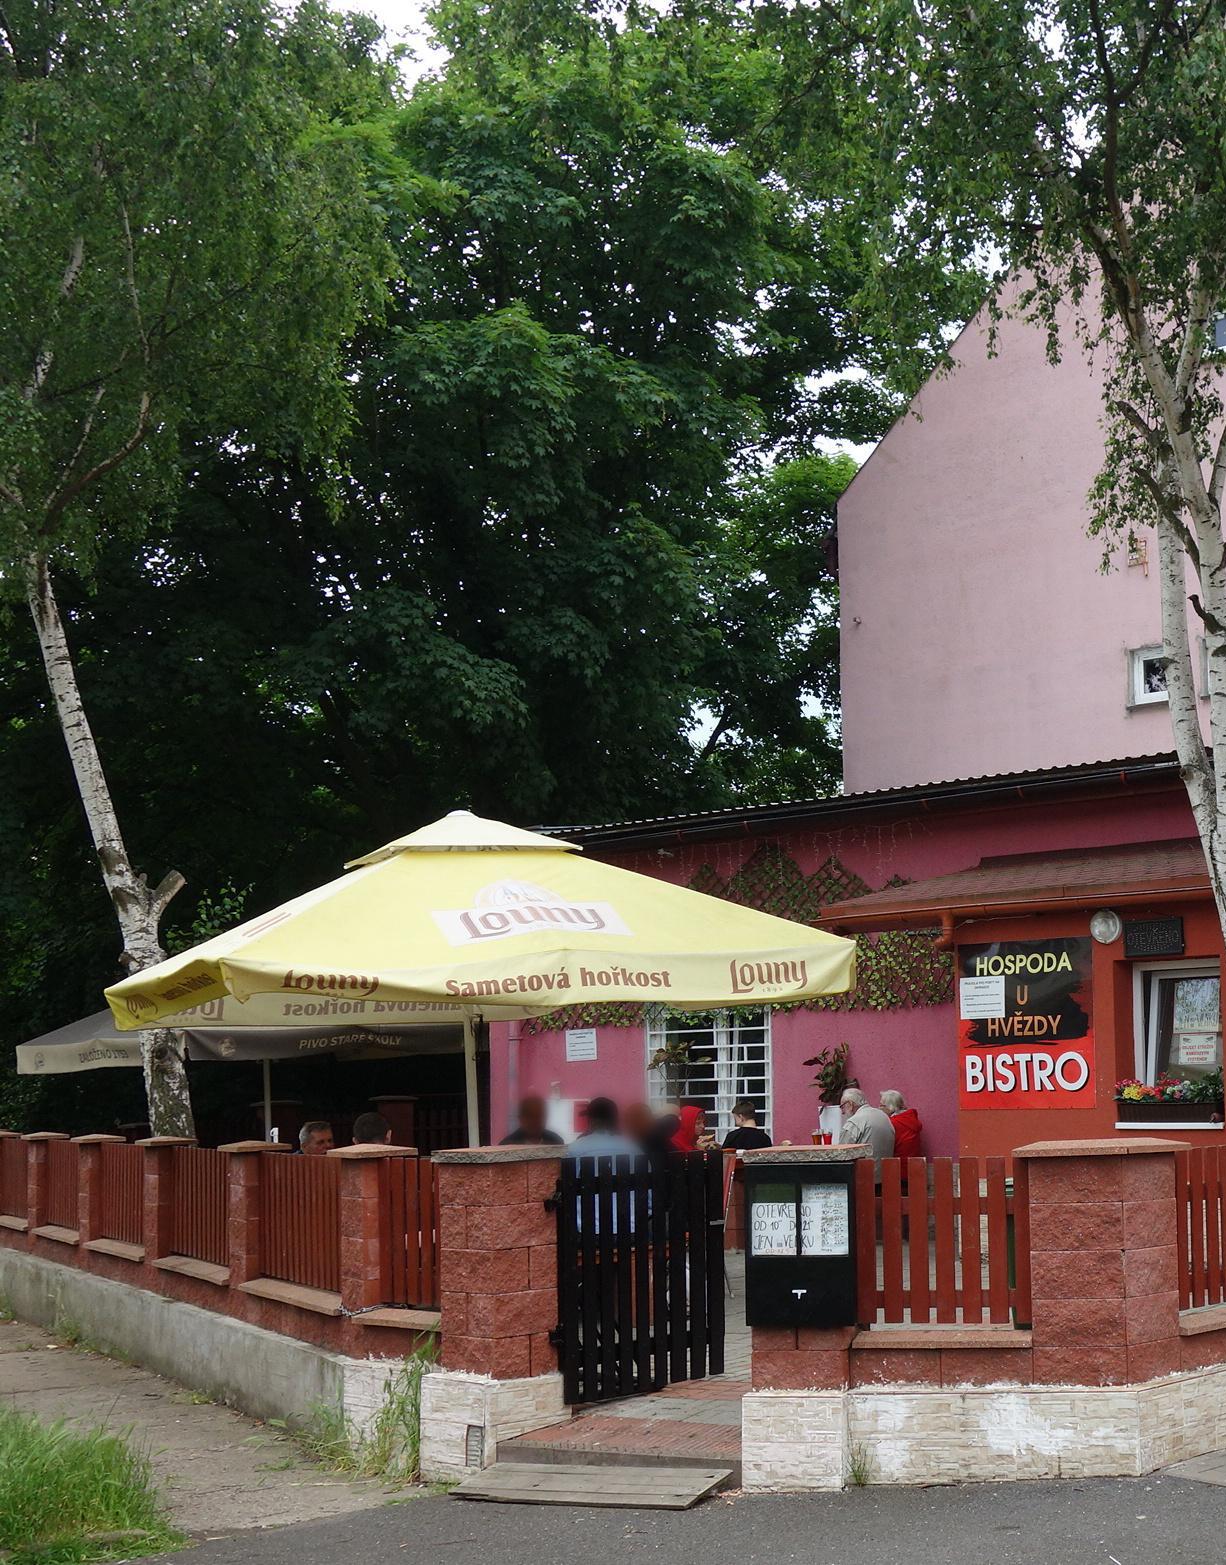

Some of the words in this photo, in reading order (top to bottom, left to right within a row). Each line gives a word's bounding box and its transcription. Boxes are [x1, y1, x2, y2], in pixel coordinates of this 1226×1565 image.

[459, 905, 606, 939] Louny
[730, 959, 808, 994] Louny
[976, 951, 1073, 976] HOSPODA
[280, 969, 380, 998] Louny
[445, 966, 571, 997] Sametová
[579, 965, 672, 989] hořkost
[1016, 985, 1028, 1005] U
[987, 1010, 1062, 1037] HVĚZDY
[299, 1038, 328, 1050] PIVO
[965, 1051, 1089, 1092] BISTRO
[784, 1235, 815, 1249] VEKU
